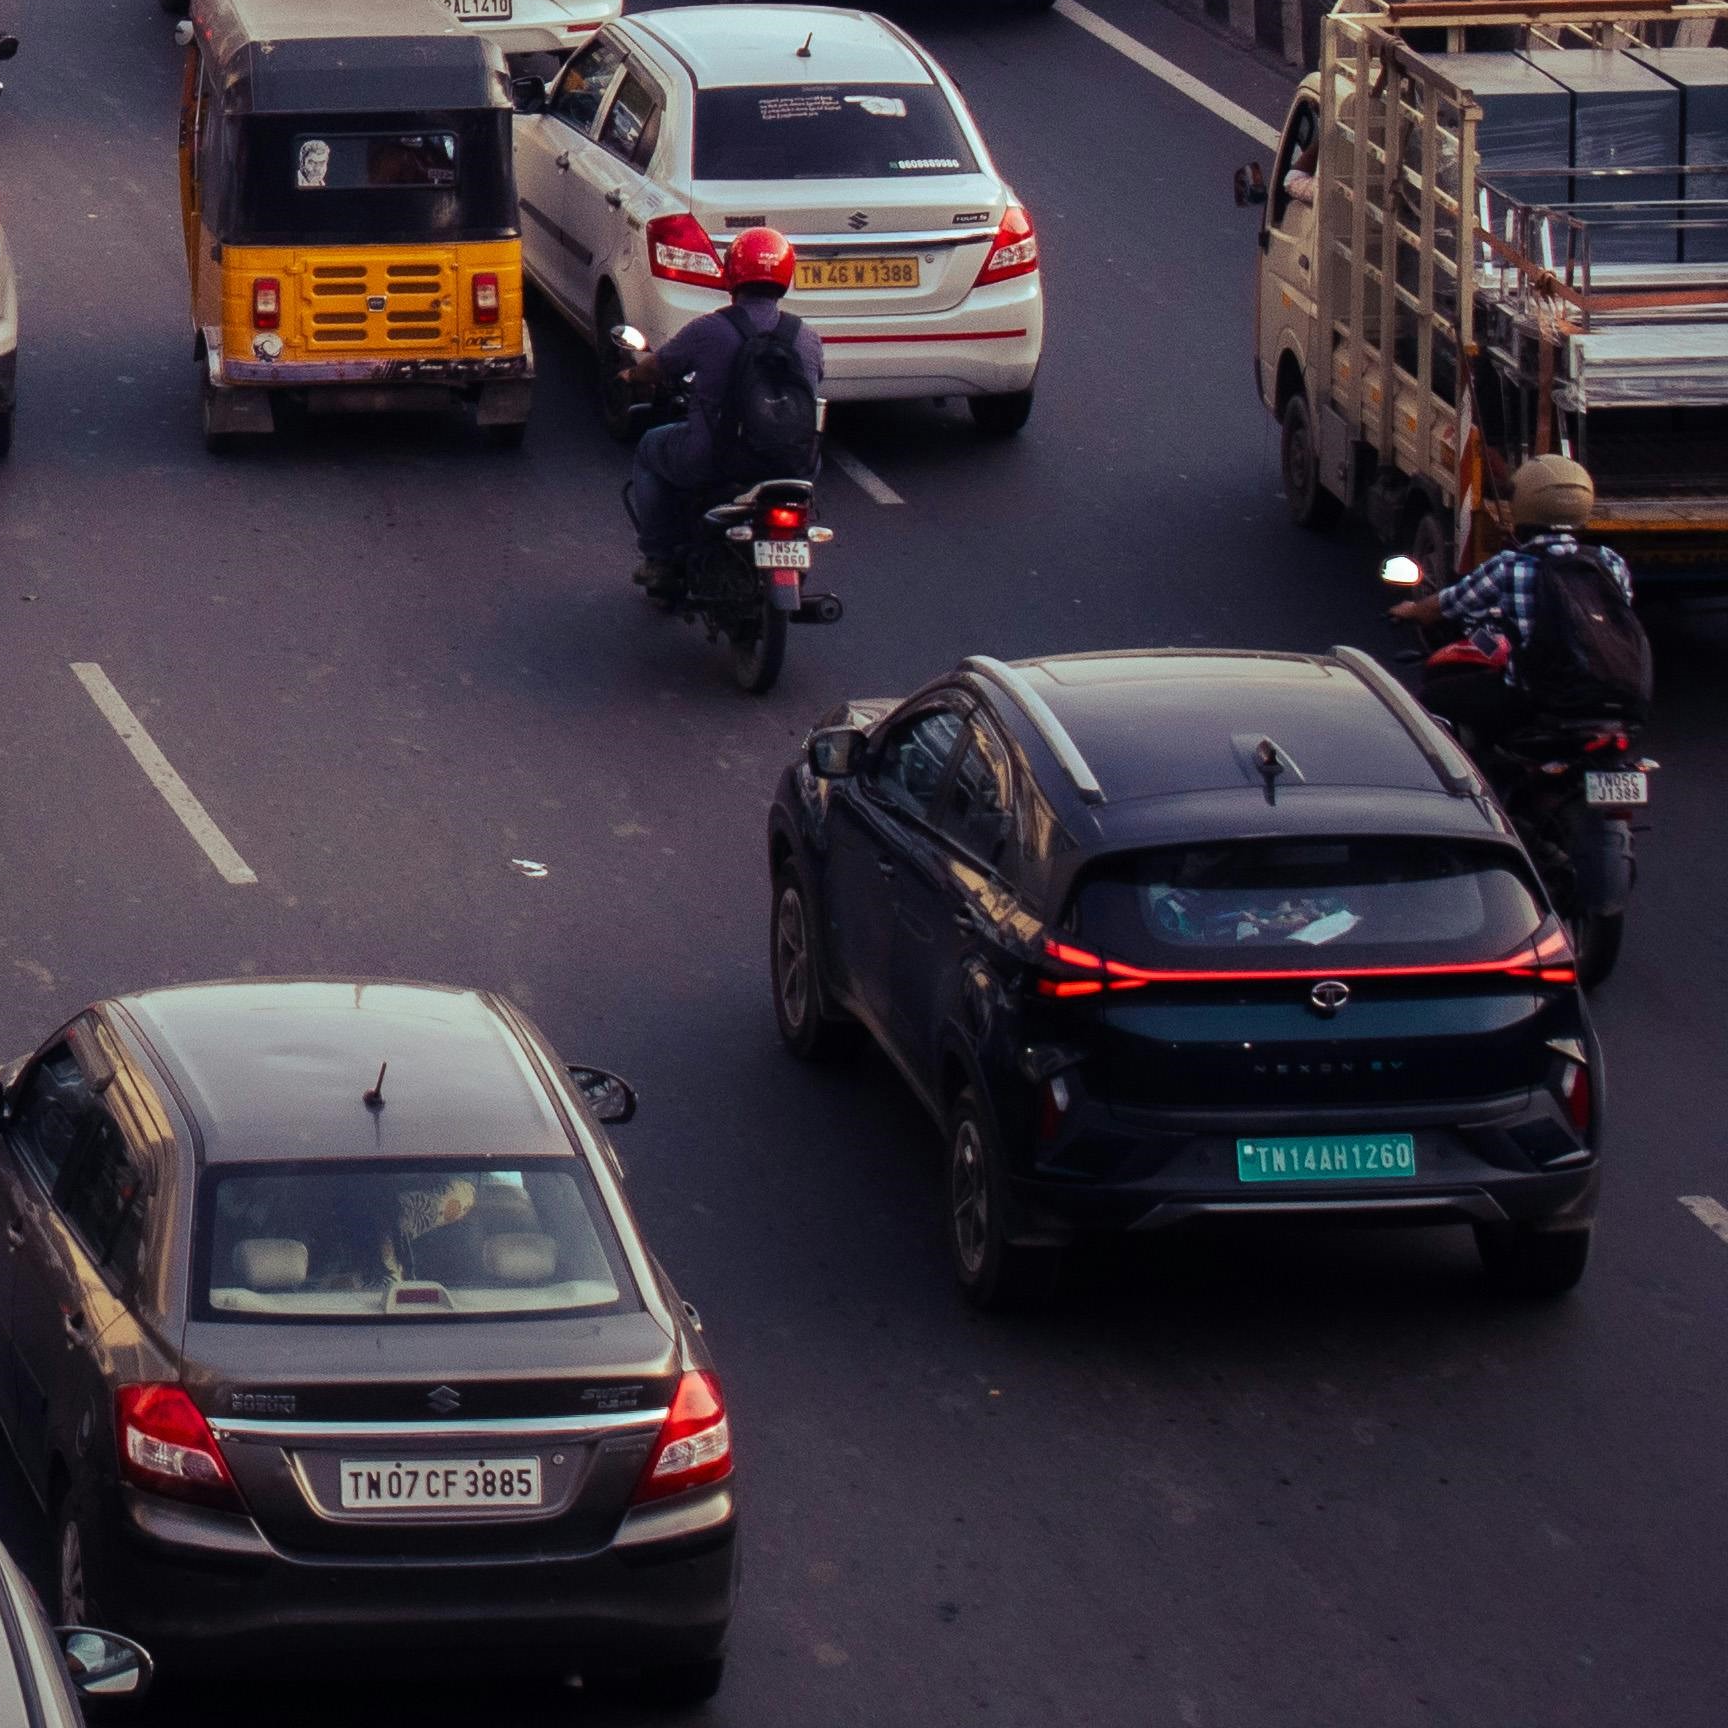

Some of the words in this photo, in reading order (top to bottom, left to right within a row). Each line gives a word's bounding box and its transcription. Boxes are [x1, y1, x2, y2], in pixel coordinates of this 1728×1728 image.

[800, 264, 823, 285] TN
[827, 263, 849, 285] 46
[870, 262, 912, 284] 1388
[1253, 1061, 1353, 1074] NEXON
[1369, 1061, 1405, 1073] EV
[1256, 1138, 1409, 1172] TN14AH1260
[349, 1470, 382, 1499] TN
[387, 1469, 420, 1498] 07
[425, 1469, 458, 1498] CF
[464, 1469, 533, 1498] 3885
